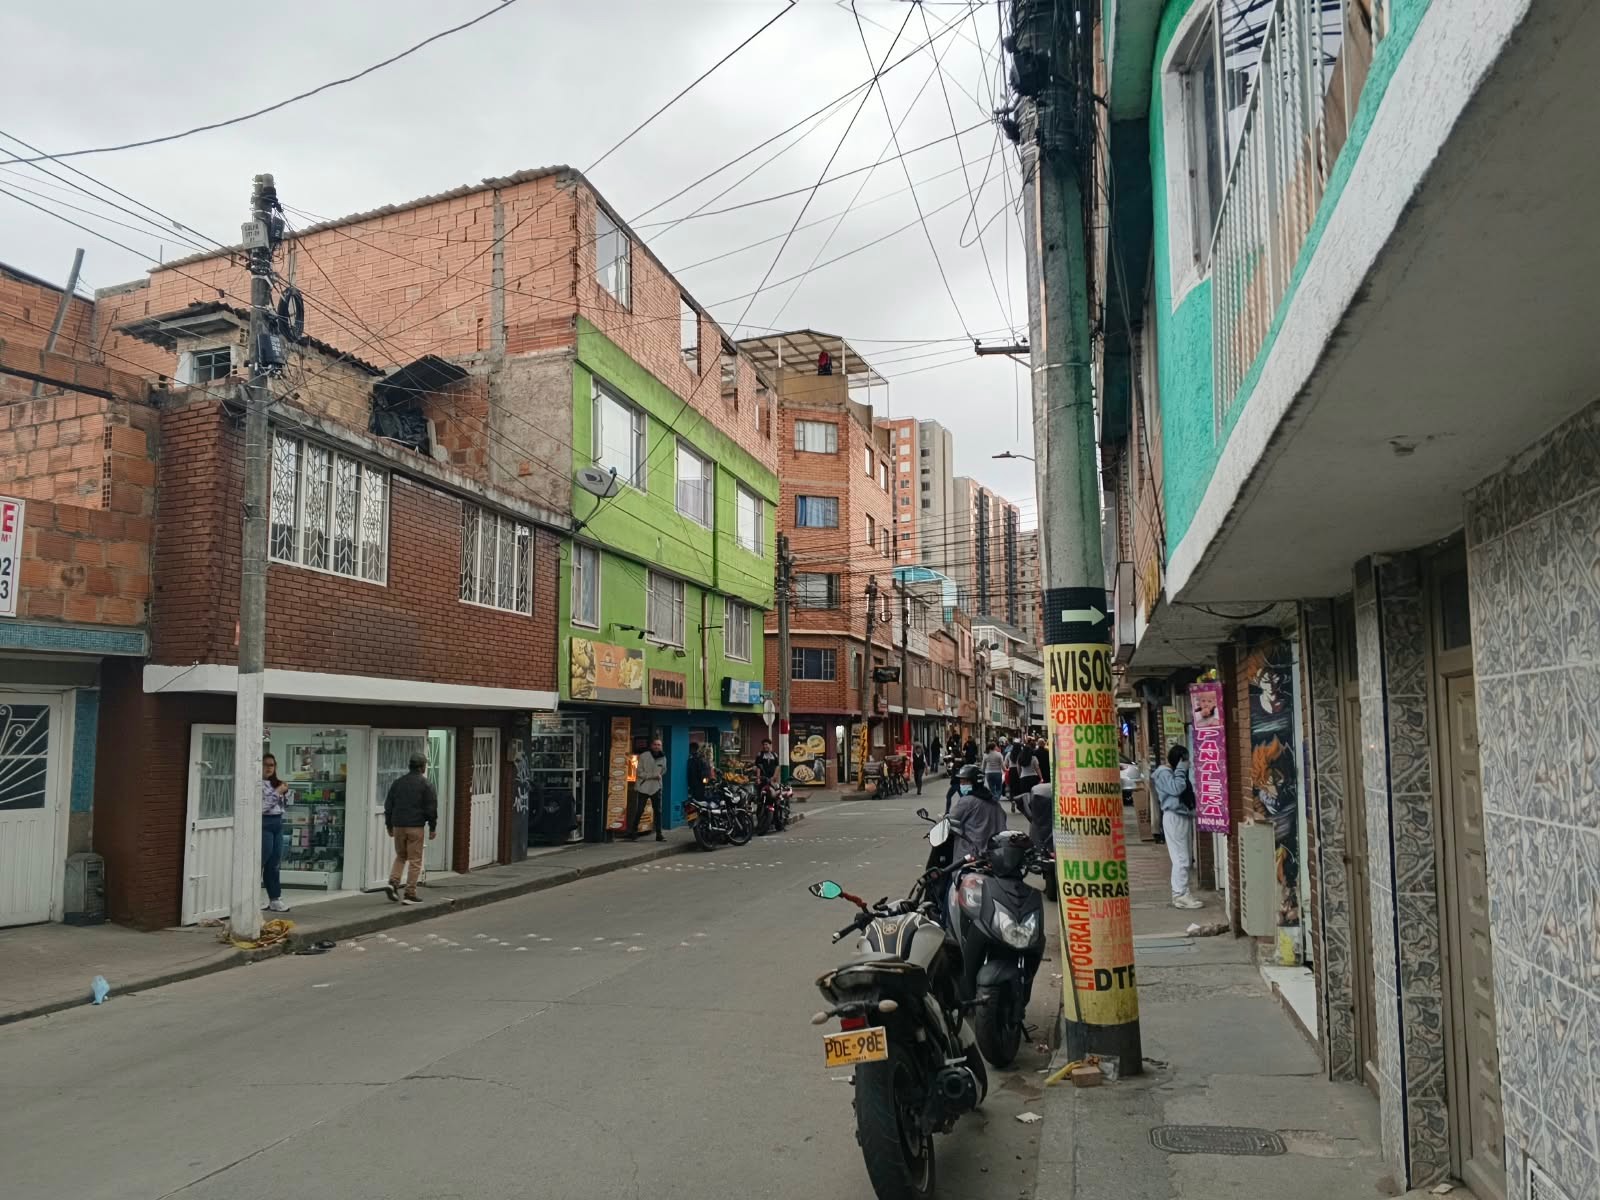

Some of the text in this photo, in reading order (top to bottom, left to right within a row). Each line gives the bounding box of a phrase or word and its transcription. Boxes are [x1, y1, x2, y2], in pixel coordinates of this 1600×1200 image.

[2, 504, 15, 533] E
[0, 557, 12, 577] 2
[0, 580, 9, 600] 3
[1050, 650, 1112, 692] AVISOS
[1076, 748, 1118, 768] LASER
[1197, 729, 1223, 817] PANALERA
[1060, 817, 1111, 836] FACTURAS
[1064, 859, 1127, 880] MUGS
[1063, 882, 1130, 898] GORRAS
[1067, 897, 1095, 991] LITOGRAFIA
